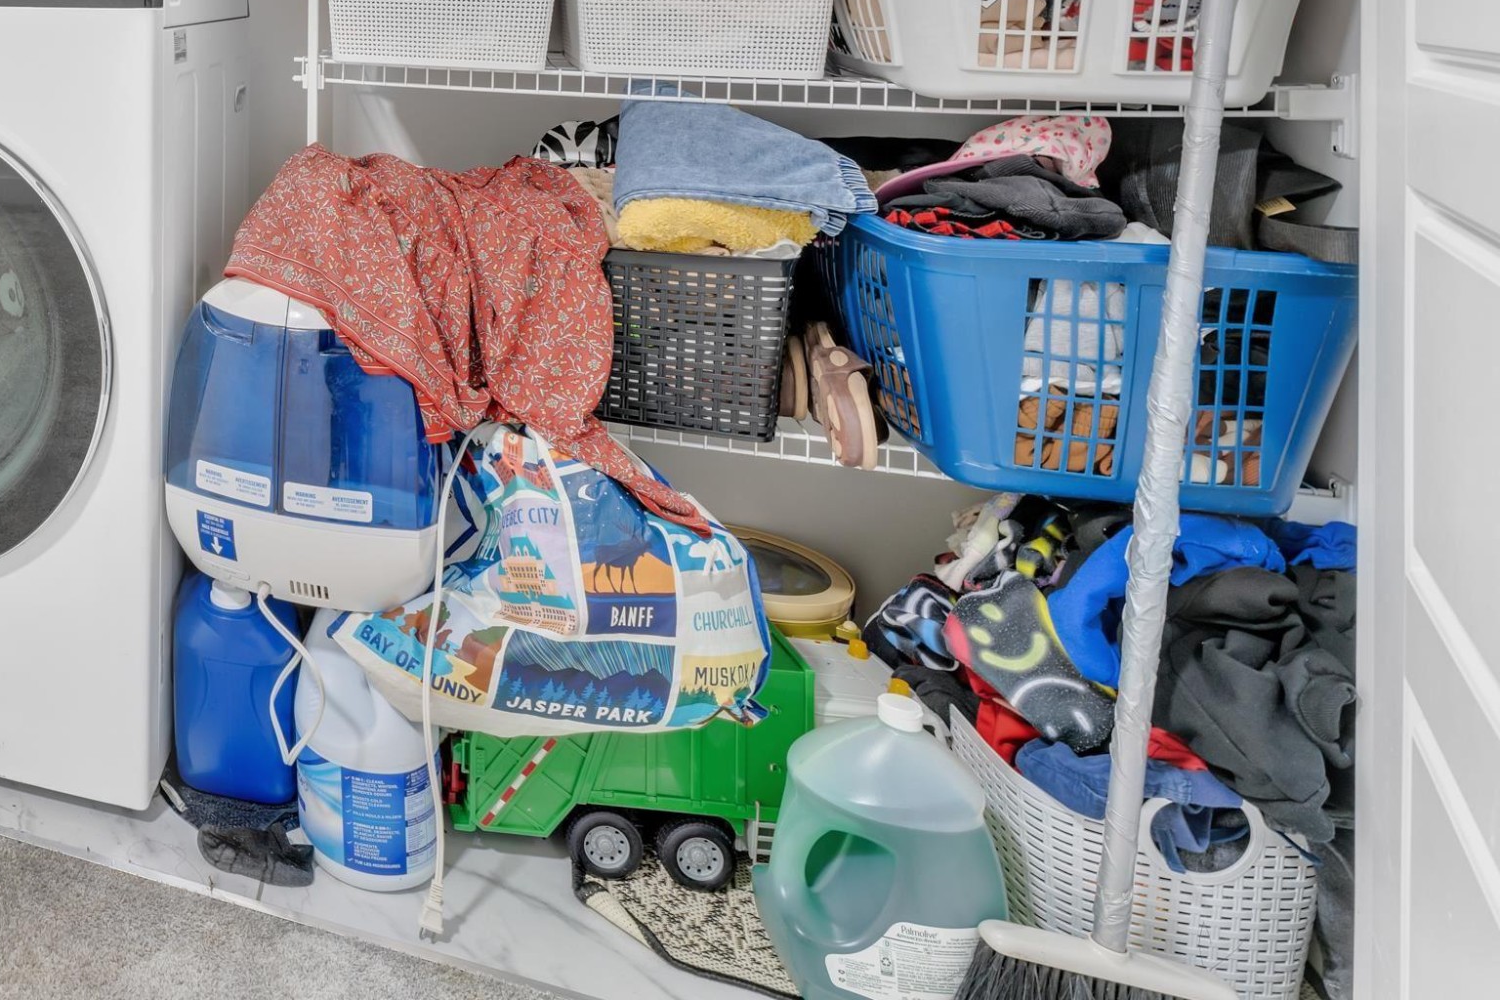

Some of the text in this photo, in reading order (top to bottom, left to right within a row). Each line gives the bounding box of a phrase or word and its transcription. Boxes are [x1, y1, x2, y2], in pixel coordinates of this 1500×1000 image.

[528, 507, 559, 526] CITY
[610, 606, 654, 628] BANFF
[693, 606, 752, 632] CHURCHILL
[361, 624, 482, 702] BAY OF UNDY
[694, 662, 756, 688] MUSKOKA
[506, 696, 653, 723] JASPER PARK
